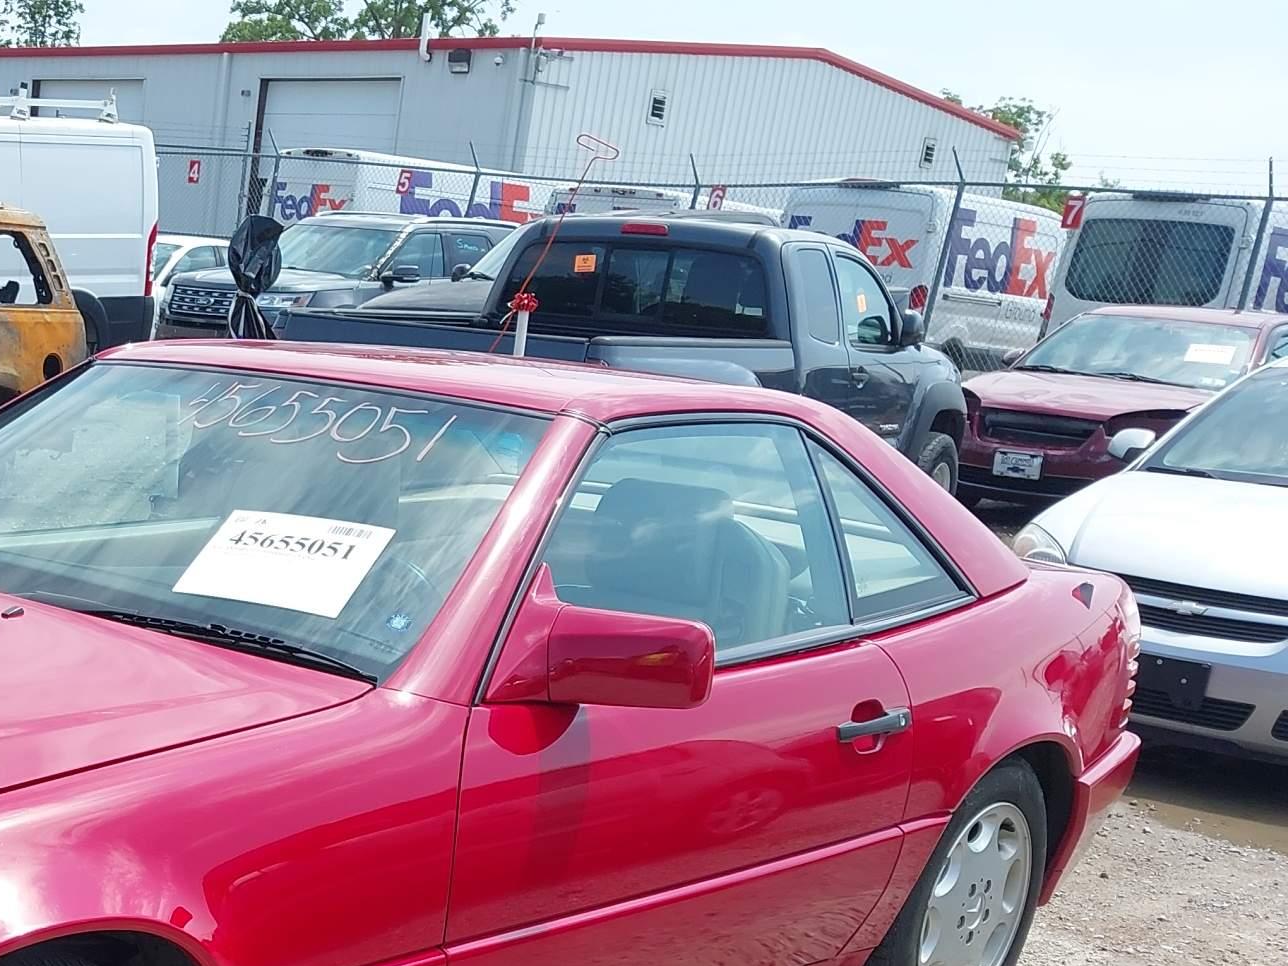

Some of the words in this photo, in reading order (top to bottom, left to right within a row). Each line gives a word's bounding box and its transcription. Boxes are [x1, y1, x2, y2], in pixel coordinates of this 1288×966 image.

[189, 162, 199, 182] 4
[398, 172, 411, 192] 5
[711, 190, 723, 209] 6
[1065, 200, 1082, 226] 7
[943, 207, 1056, 299] FedEx
[177, 381, 458, 463] 45655051
[229, 529, 356, 560] 45655051
